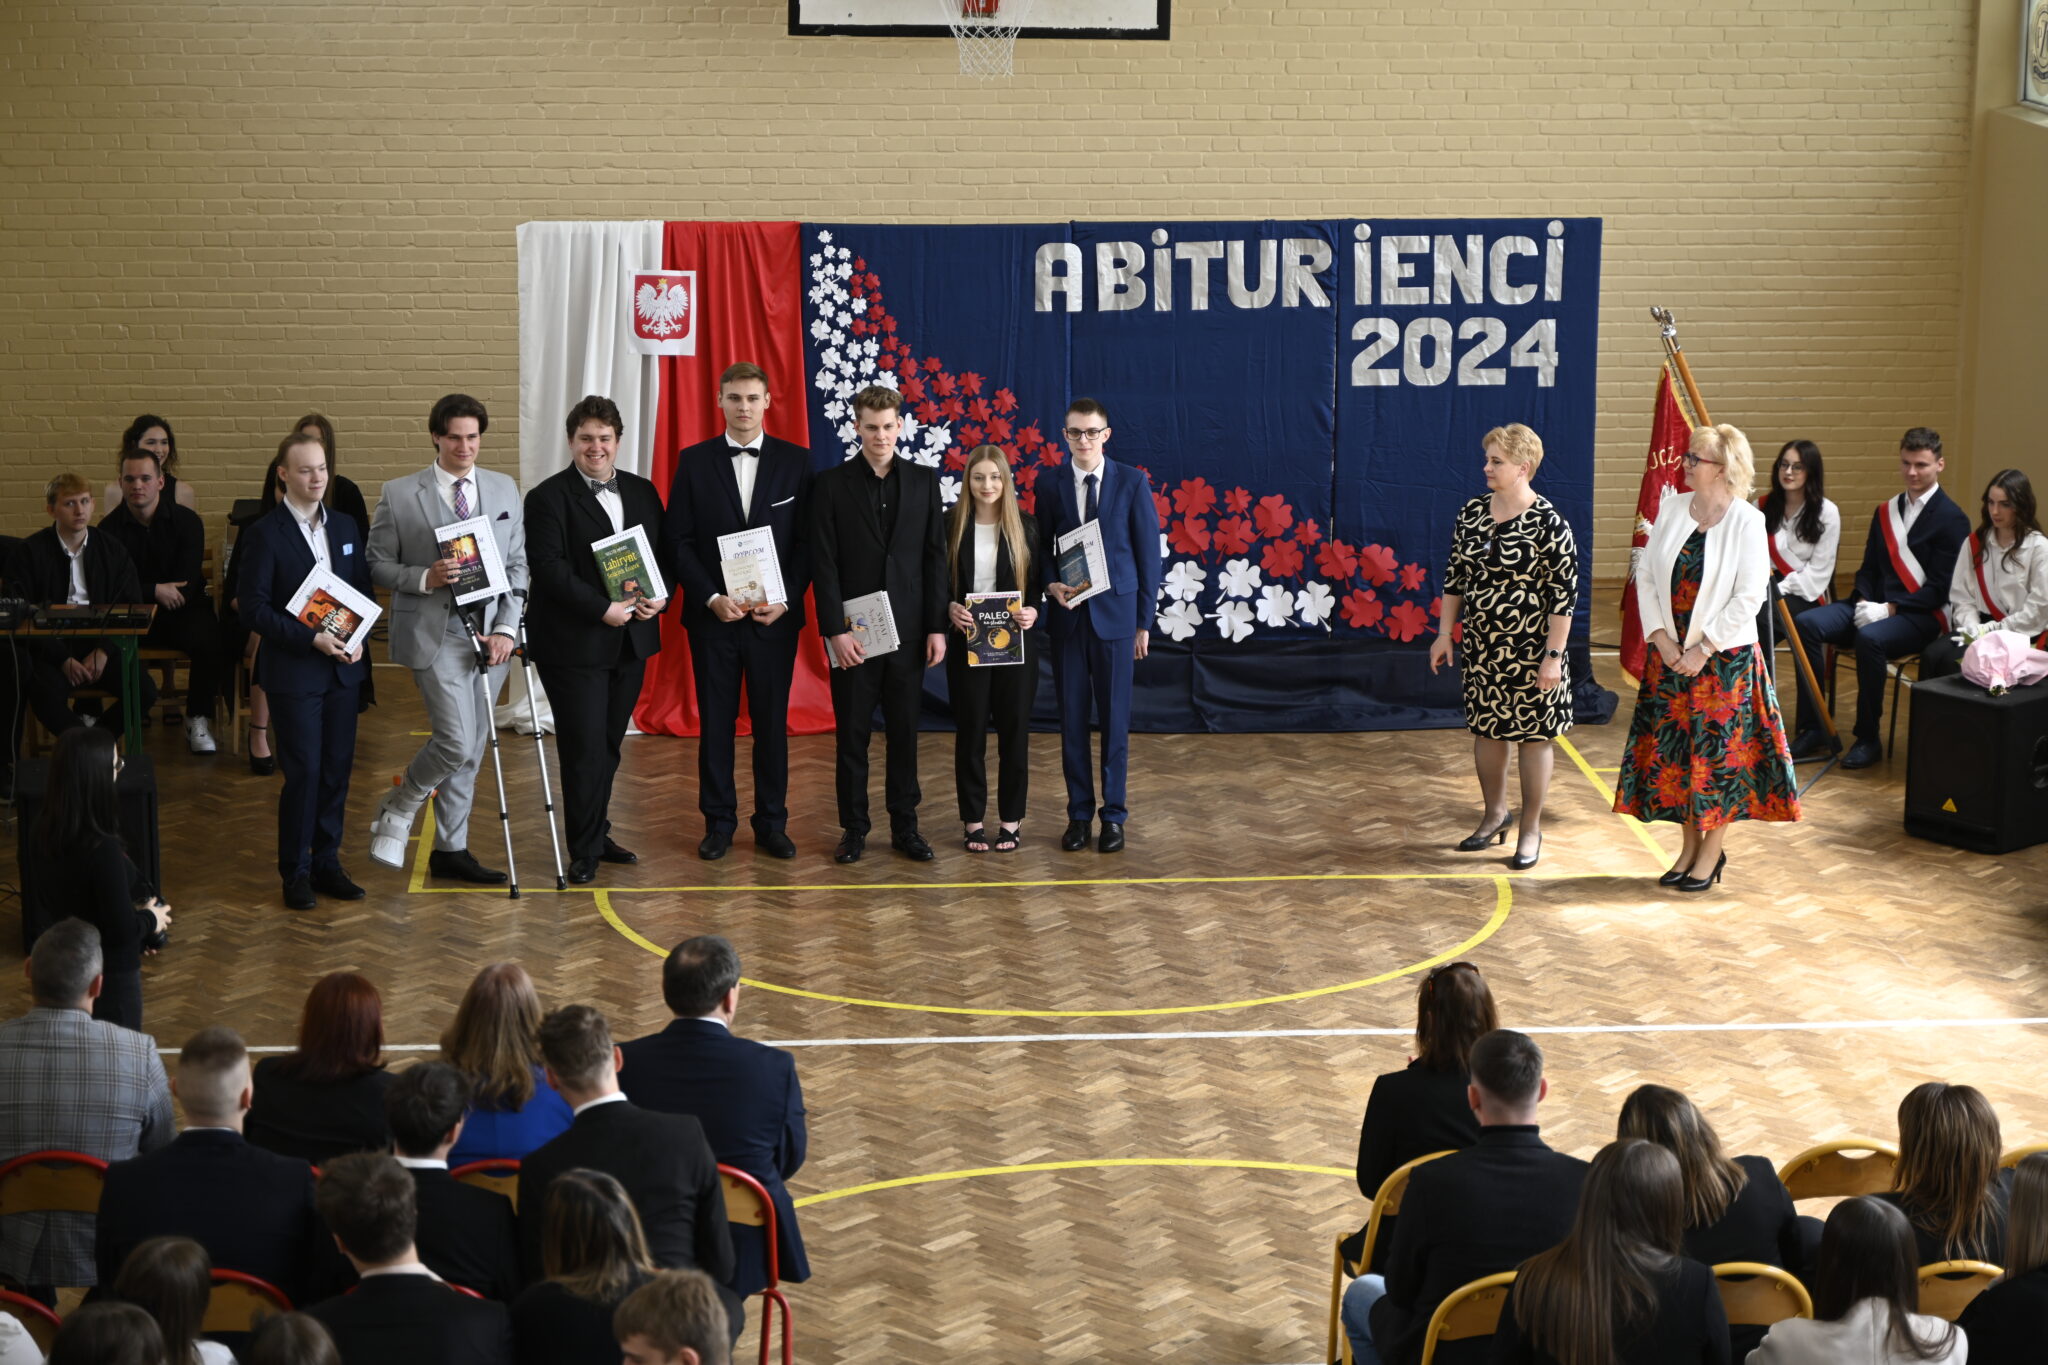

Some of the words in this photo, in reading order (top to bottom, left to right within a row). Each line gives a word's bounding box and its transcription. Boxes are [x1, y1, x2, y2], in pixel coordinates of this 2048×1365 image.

[1351, 316, 1559, 387] 2024
[603, 552, 638, 572] Labirynt
[320, 609, 337, 627] BRAD
[324, 607, 350, 637] THOR
[978, 611, 1010, 620] PALEO
